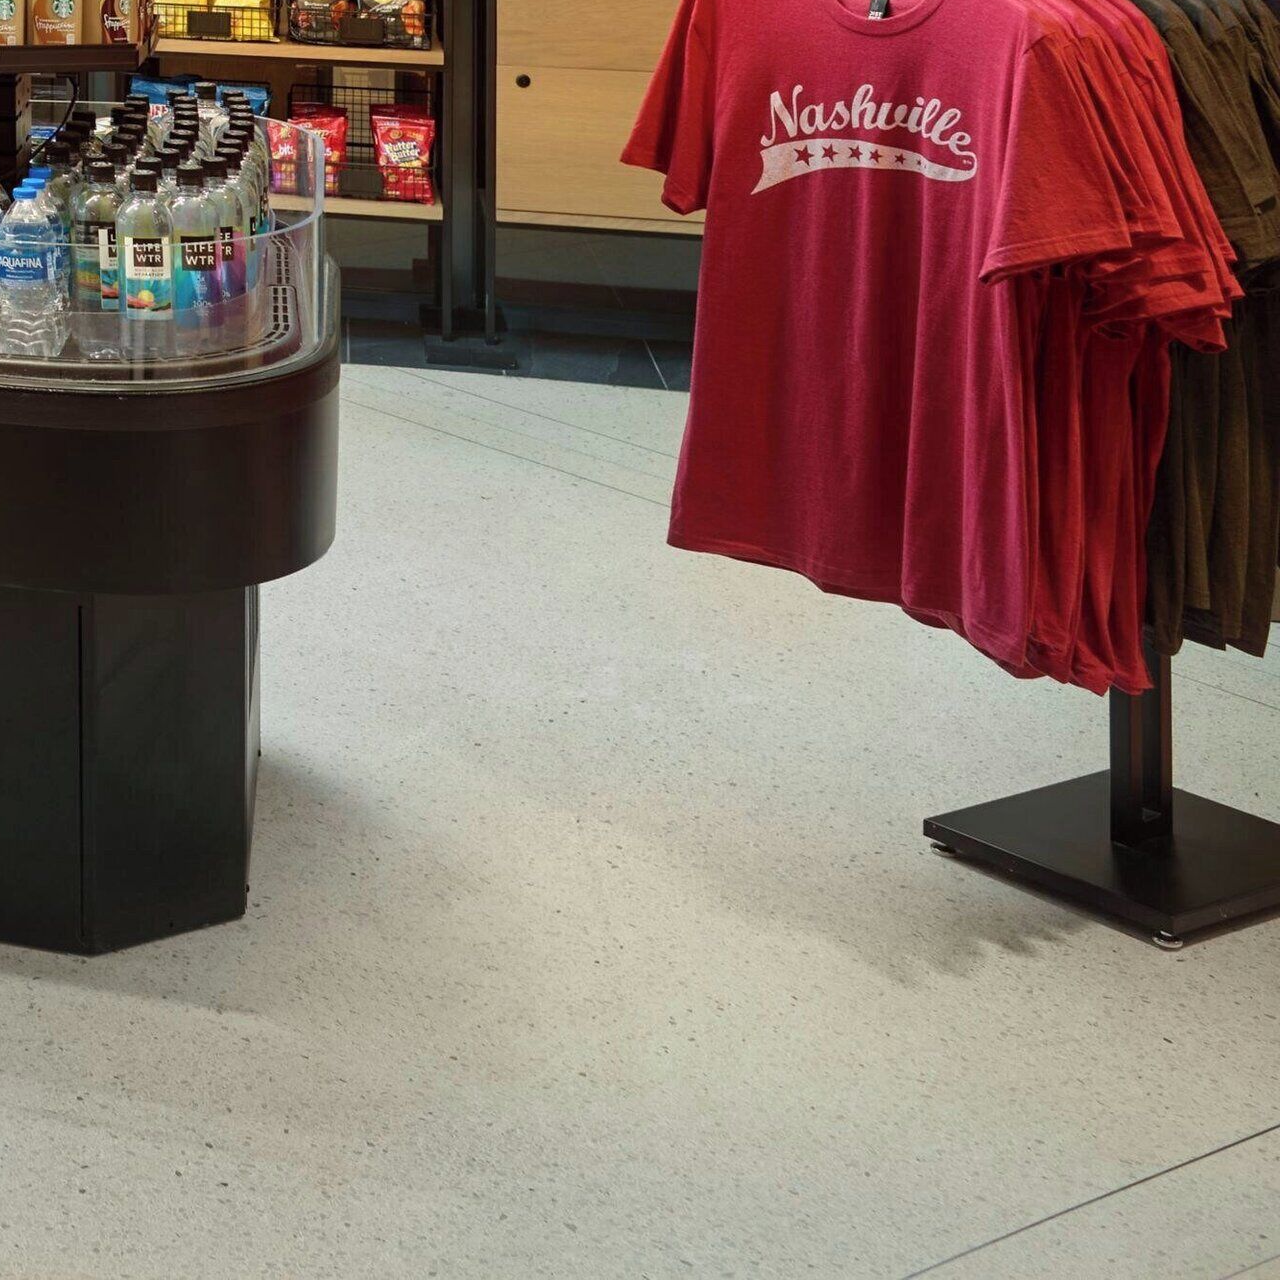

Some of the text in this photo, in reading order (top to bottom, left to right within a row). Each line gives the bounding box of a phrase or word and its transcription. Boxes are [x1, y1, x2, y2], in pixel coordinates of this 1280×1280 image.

[760, 84, 977, 164] Nashville
[135, 243, 161, 252] LIFE
[185, 243, 213, 253] LIFE
[0, 255, 42, 269] AQUAFINA
[136, 254, 161, 263] WTR
[186, 255, 215, 265] WTR
